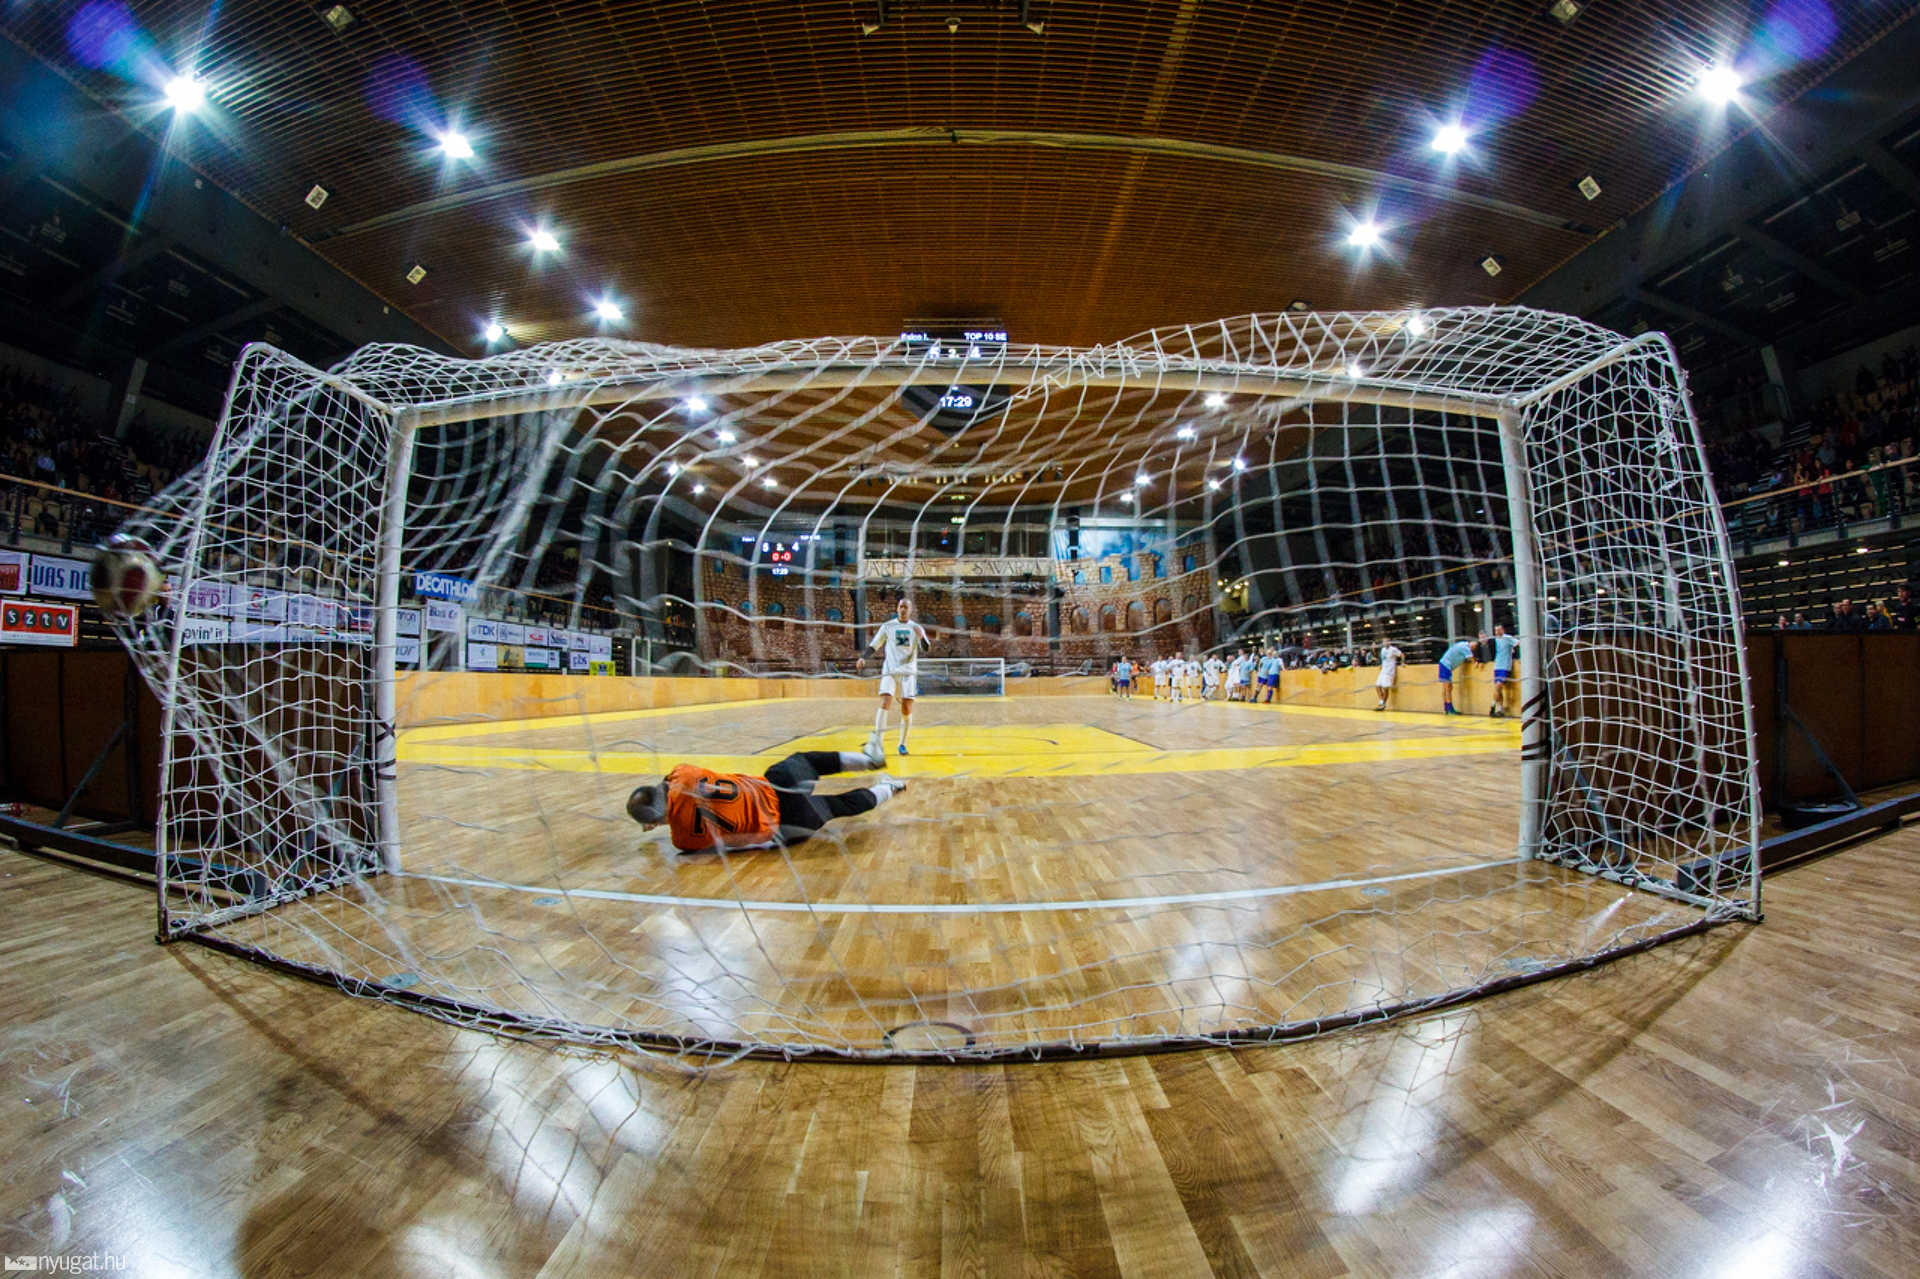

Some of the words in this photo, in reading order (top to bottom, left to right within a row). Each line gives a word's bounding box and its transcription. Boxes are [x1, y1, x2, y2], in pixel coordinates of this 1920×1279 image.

[964, 332, 982, 341] TOP
[983, 332, 994, 341] 10
[939, 396, 973, 408] 17:29
[416, 574, 478, 600] DECATHLON
